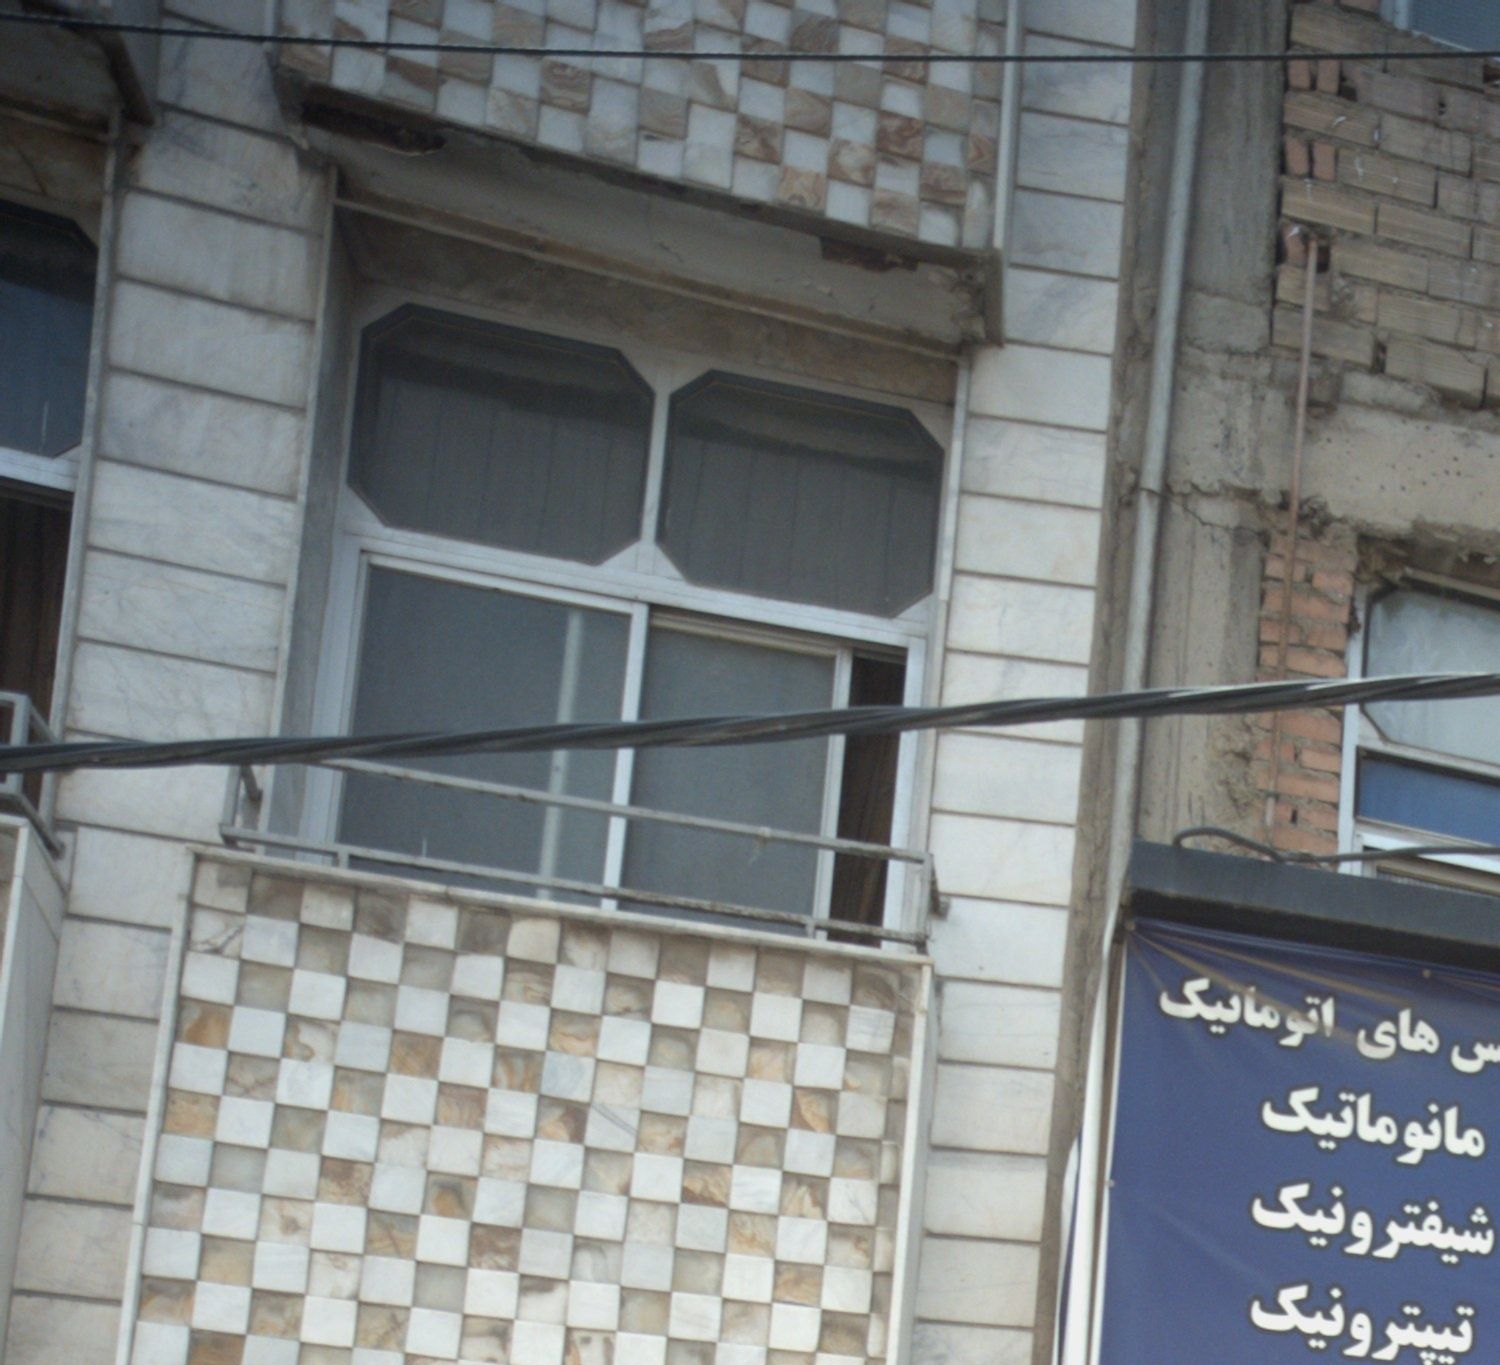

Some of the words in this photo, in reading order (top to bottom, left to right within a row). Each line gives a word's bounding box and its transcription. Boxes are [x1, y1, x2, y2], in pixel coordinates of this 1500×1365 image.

[1159, 978, 1336, 1047] اتوماتیک
[1356, 1008, 1440, 1060] های
[1261, 1086, 1487, 1165] مانوماتیک
[1251, 1182, 1495, 1263] شیفترونیک
